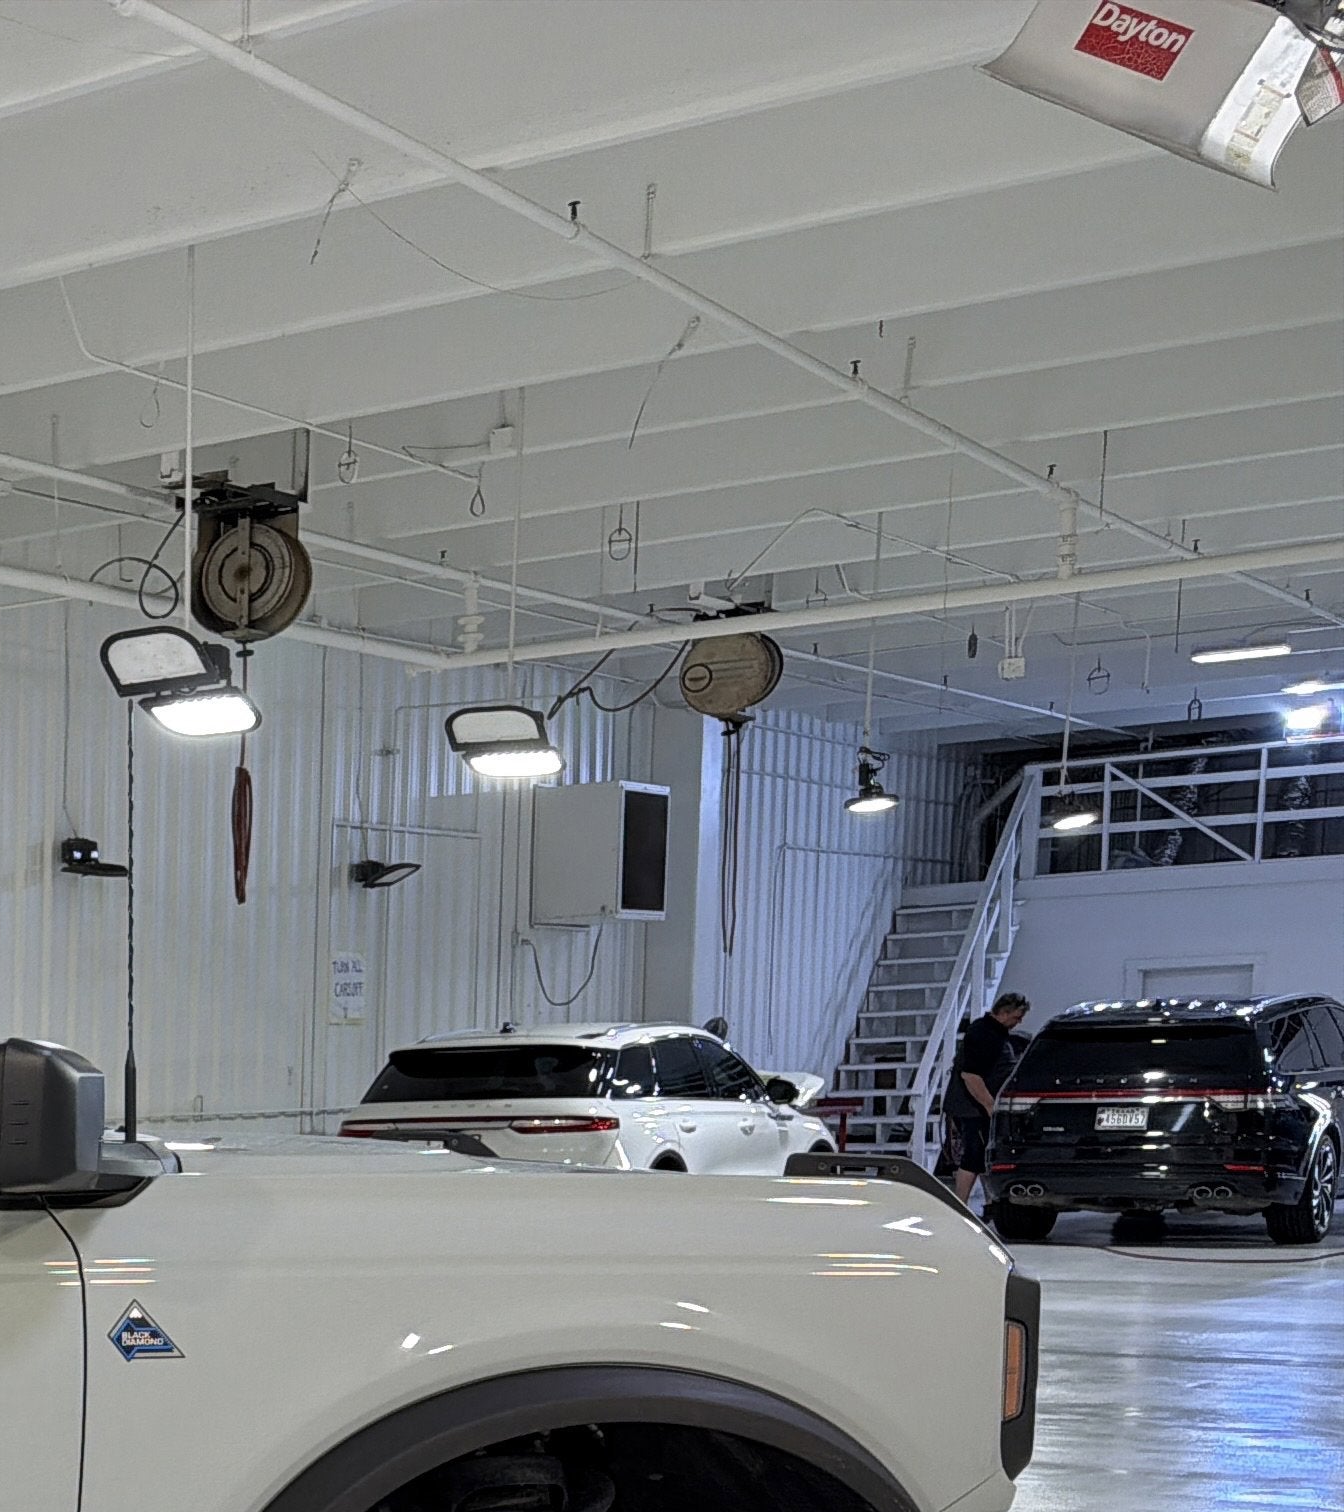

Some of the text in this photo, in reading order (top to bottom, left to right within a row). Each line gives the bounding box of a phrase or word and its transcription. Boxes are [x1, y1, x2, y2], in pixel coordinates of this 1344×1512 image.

[1092, 2, 1186, 53] Dayton
[332, 959, 363, 975] TURN ALL
[121, 1331, 150, 1339] BLACK
[121, 1338, 164, 1346] DIAMOND
